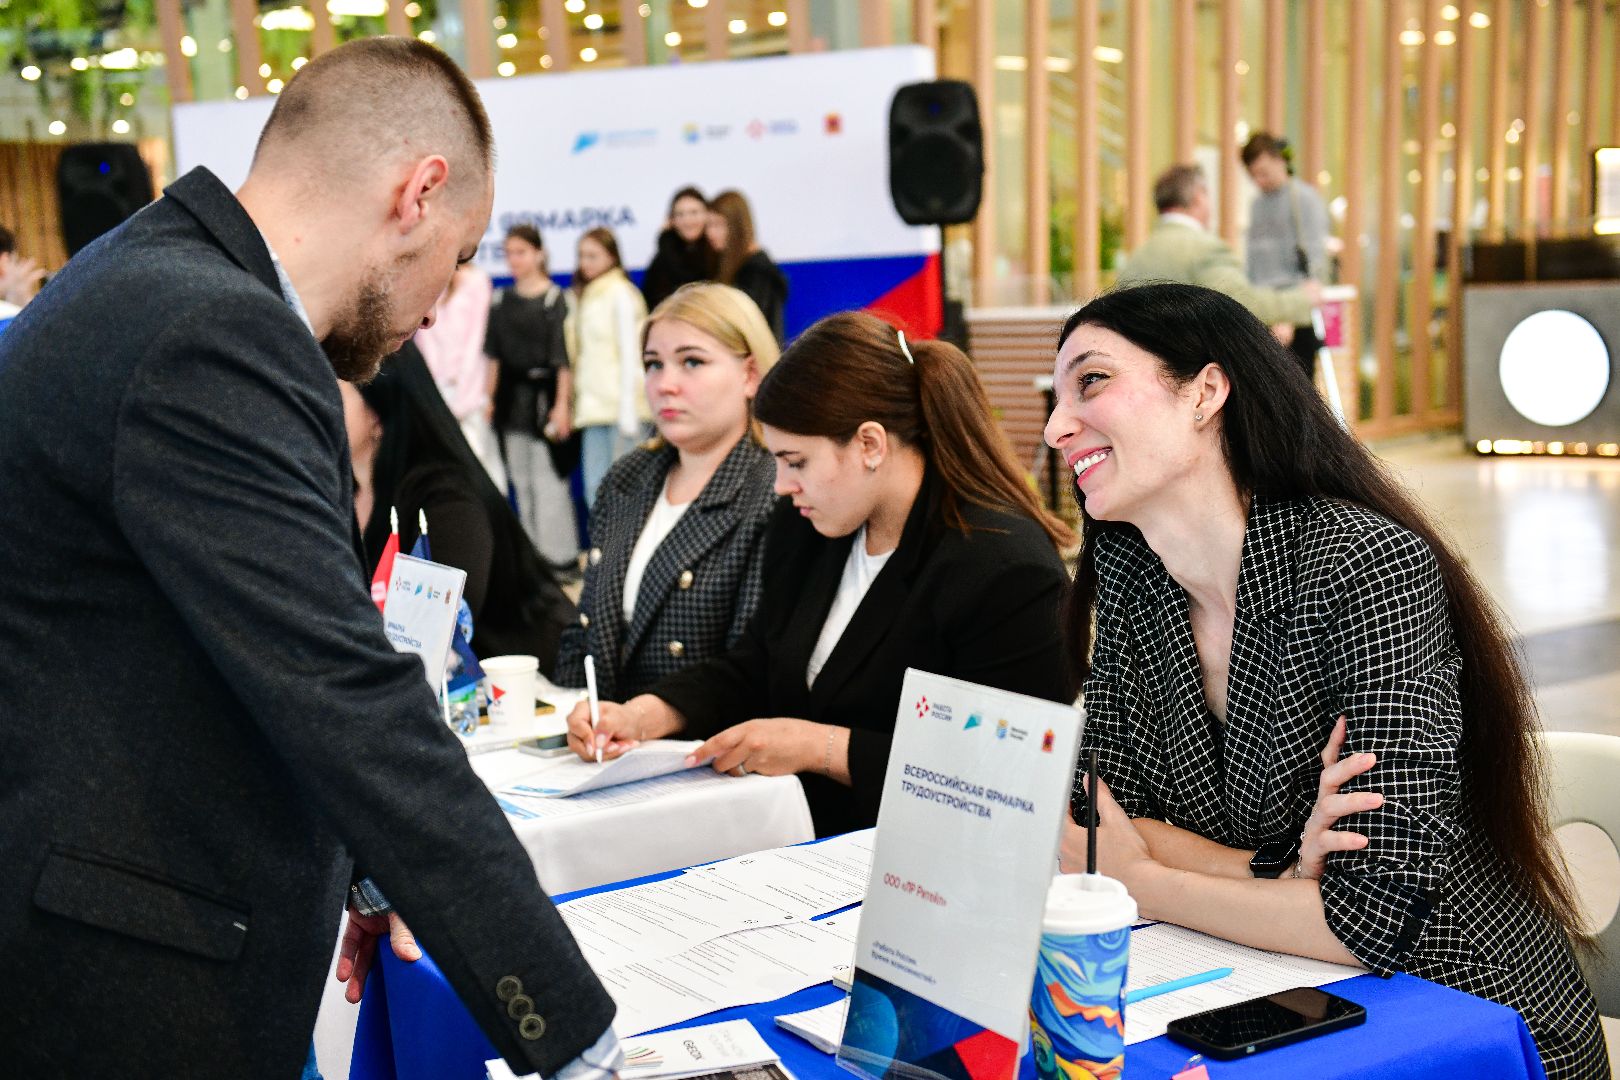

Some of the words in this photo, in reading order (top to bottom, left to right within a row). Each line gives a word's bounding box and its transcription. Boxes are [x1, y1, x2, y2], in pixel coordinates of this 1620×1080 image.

[901, 780, 991, 818] ТРУДОУСТРОЙСТВА
[903, 764, 984, 798] ВСЕРОССИЙСКАЯ
[985, 788, 1034, 814] ЯРМАРКА
